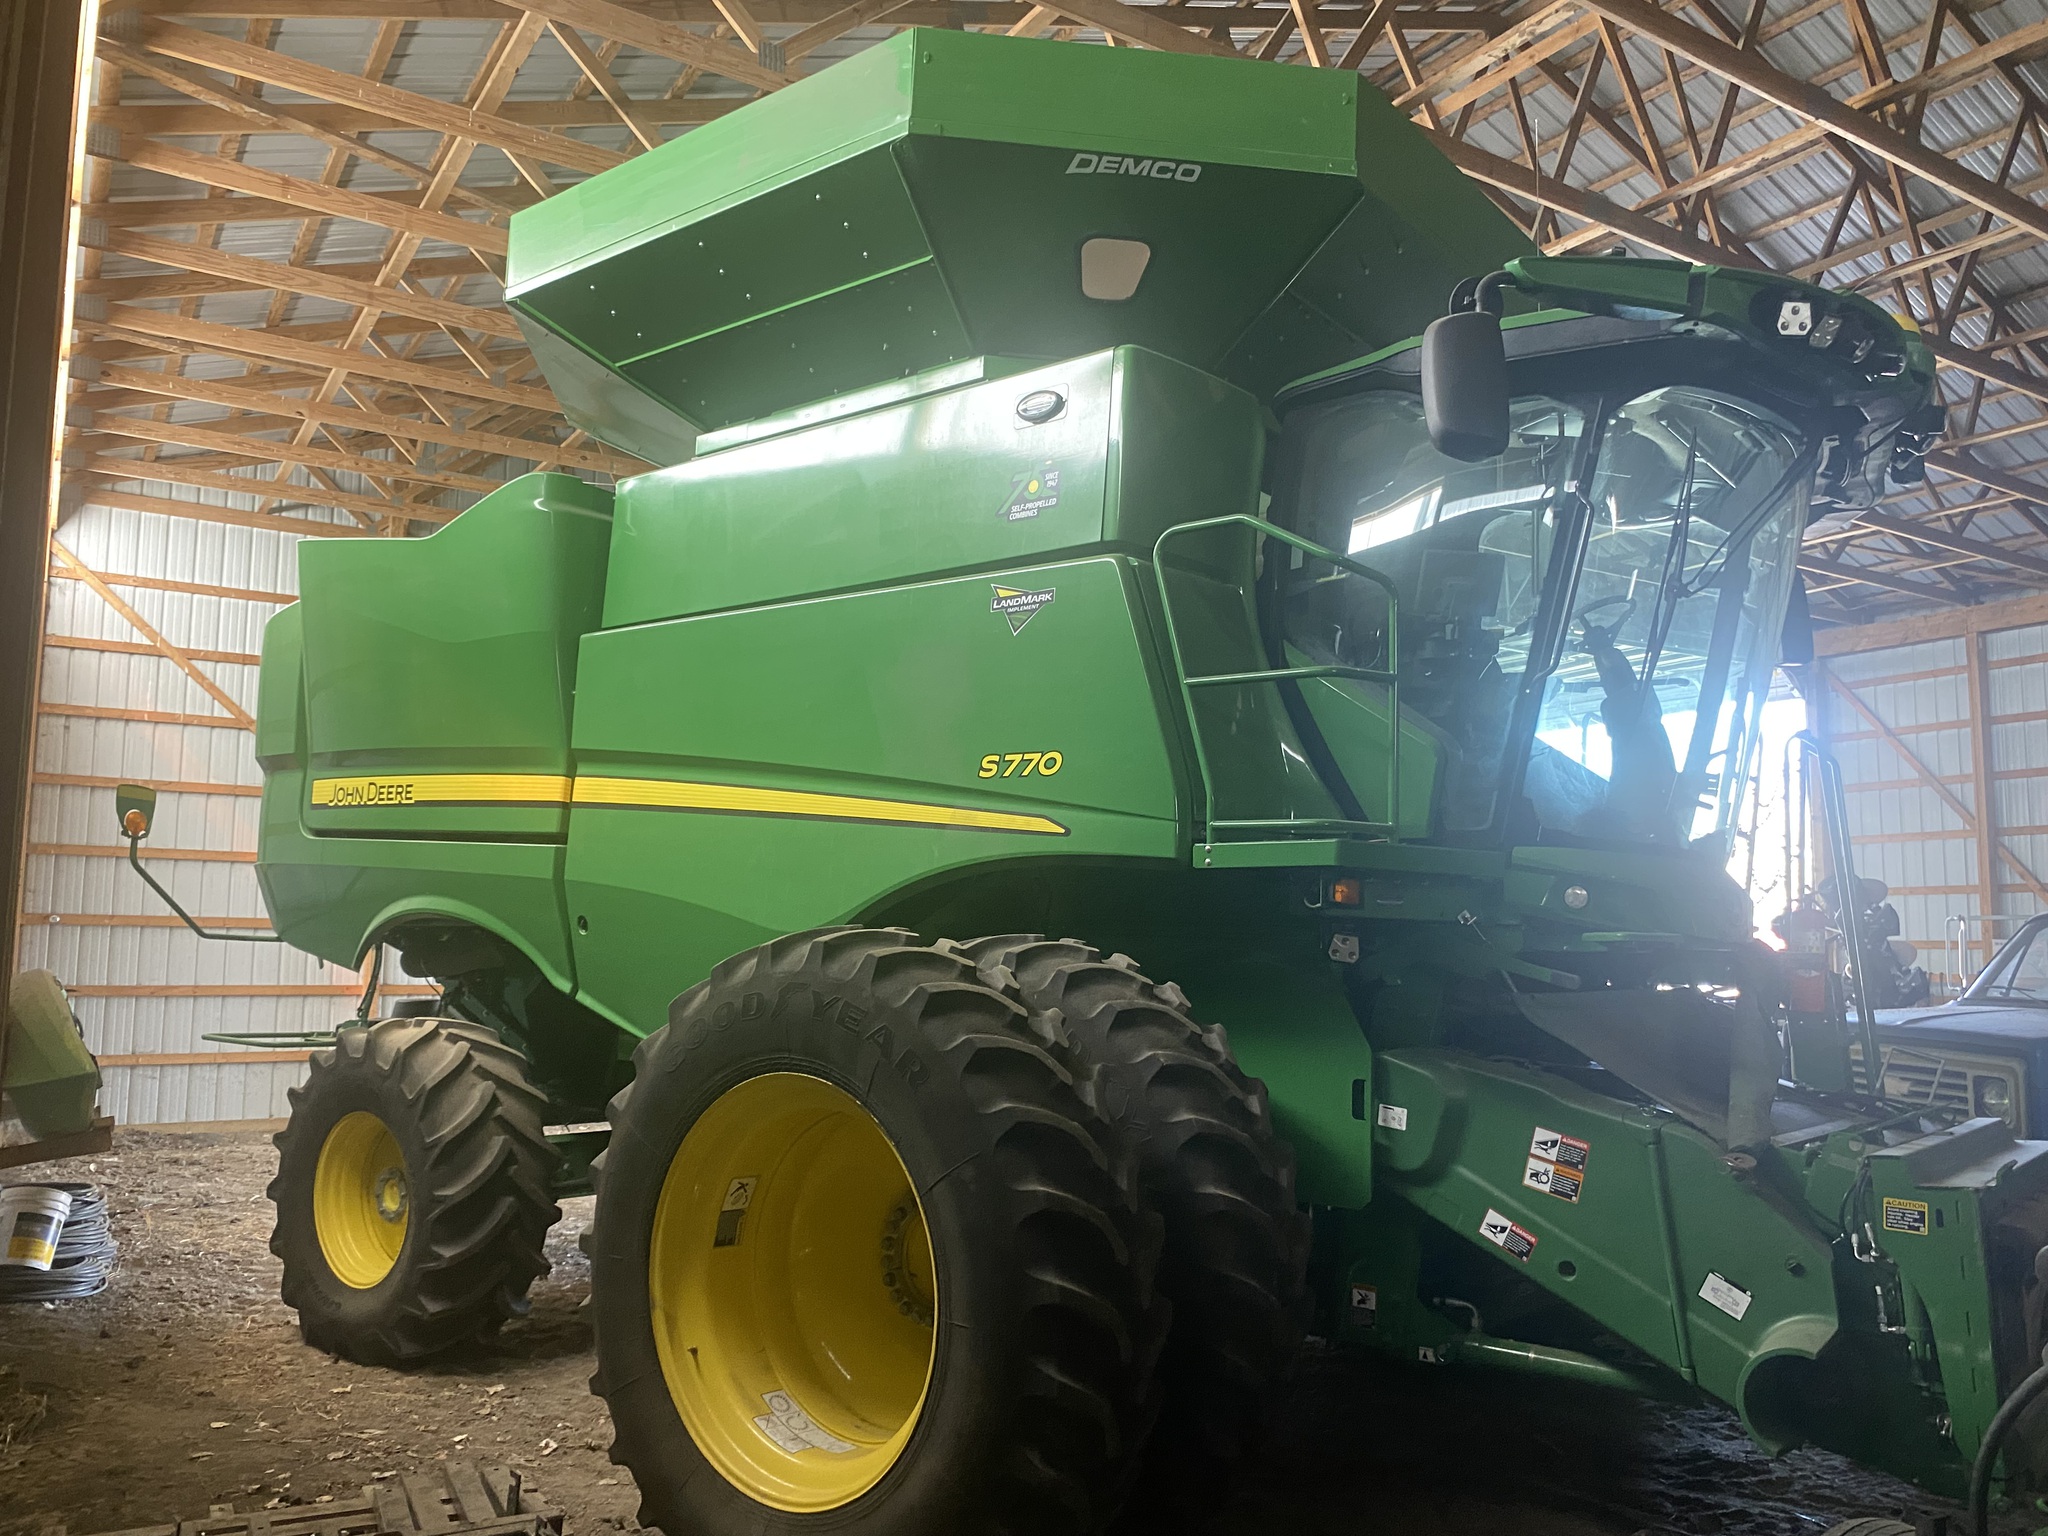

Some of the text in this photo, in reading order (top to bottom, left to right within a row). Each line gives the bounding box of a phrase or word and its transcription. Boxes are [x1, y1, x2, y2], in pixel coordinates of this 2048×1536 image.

[1065, 153, 1202, 183] DEMCO
[1011, 498, 1057, 513] SELF-PROPELLED
[1009, 509, 1038, 520] COMBINES
[1007, 603, 1040, 613] IMPLEMENT
[978, 750, 1063, 779] S770
[328, 782, 414, 805] JOHN DEERE
[1891, 1200, 1926, 1210] CAUTION
